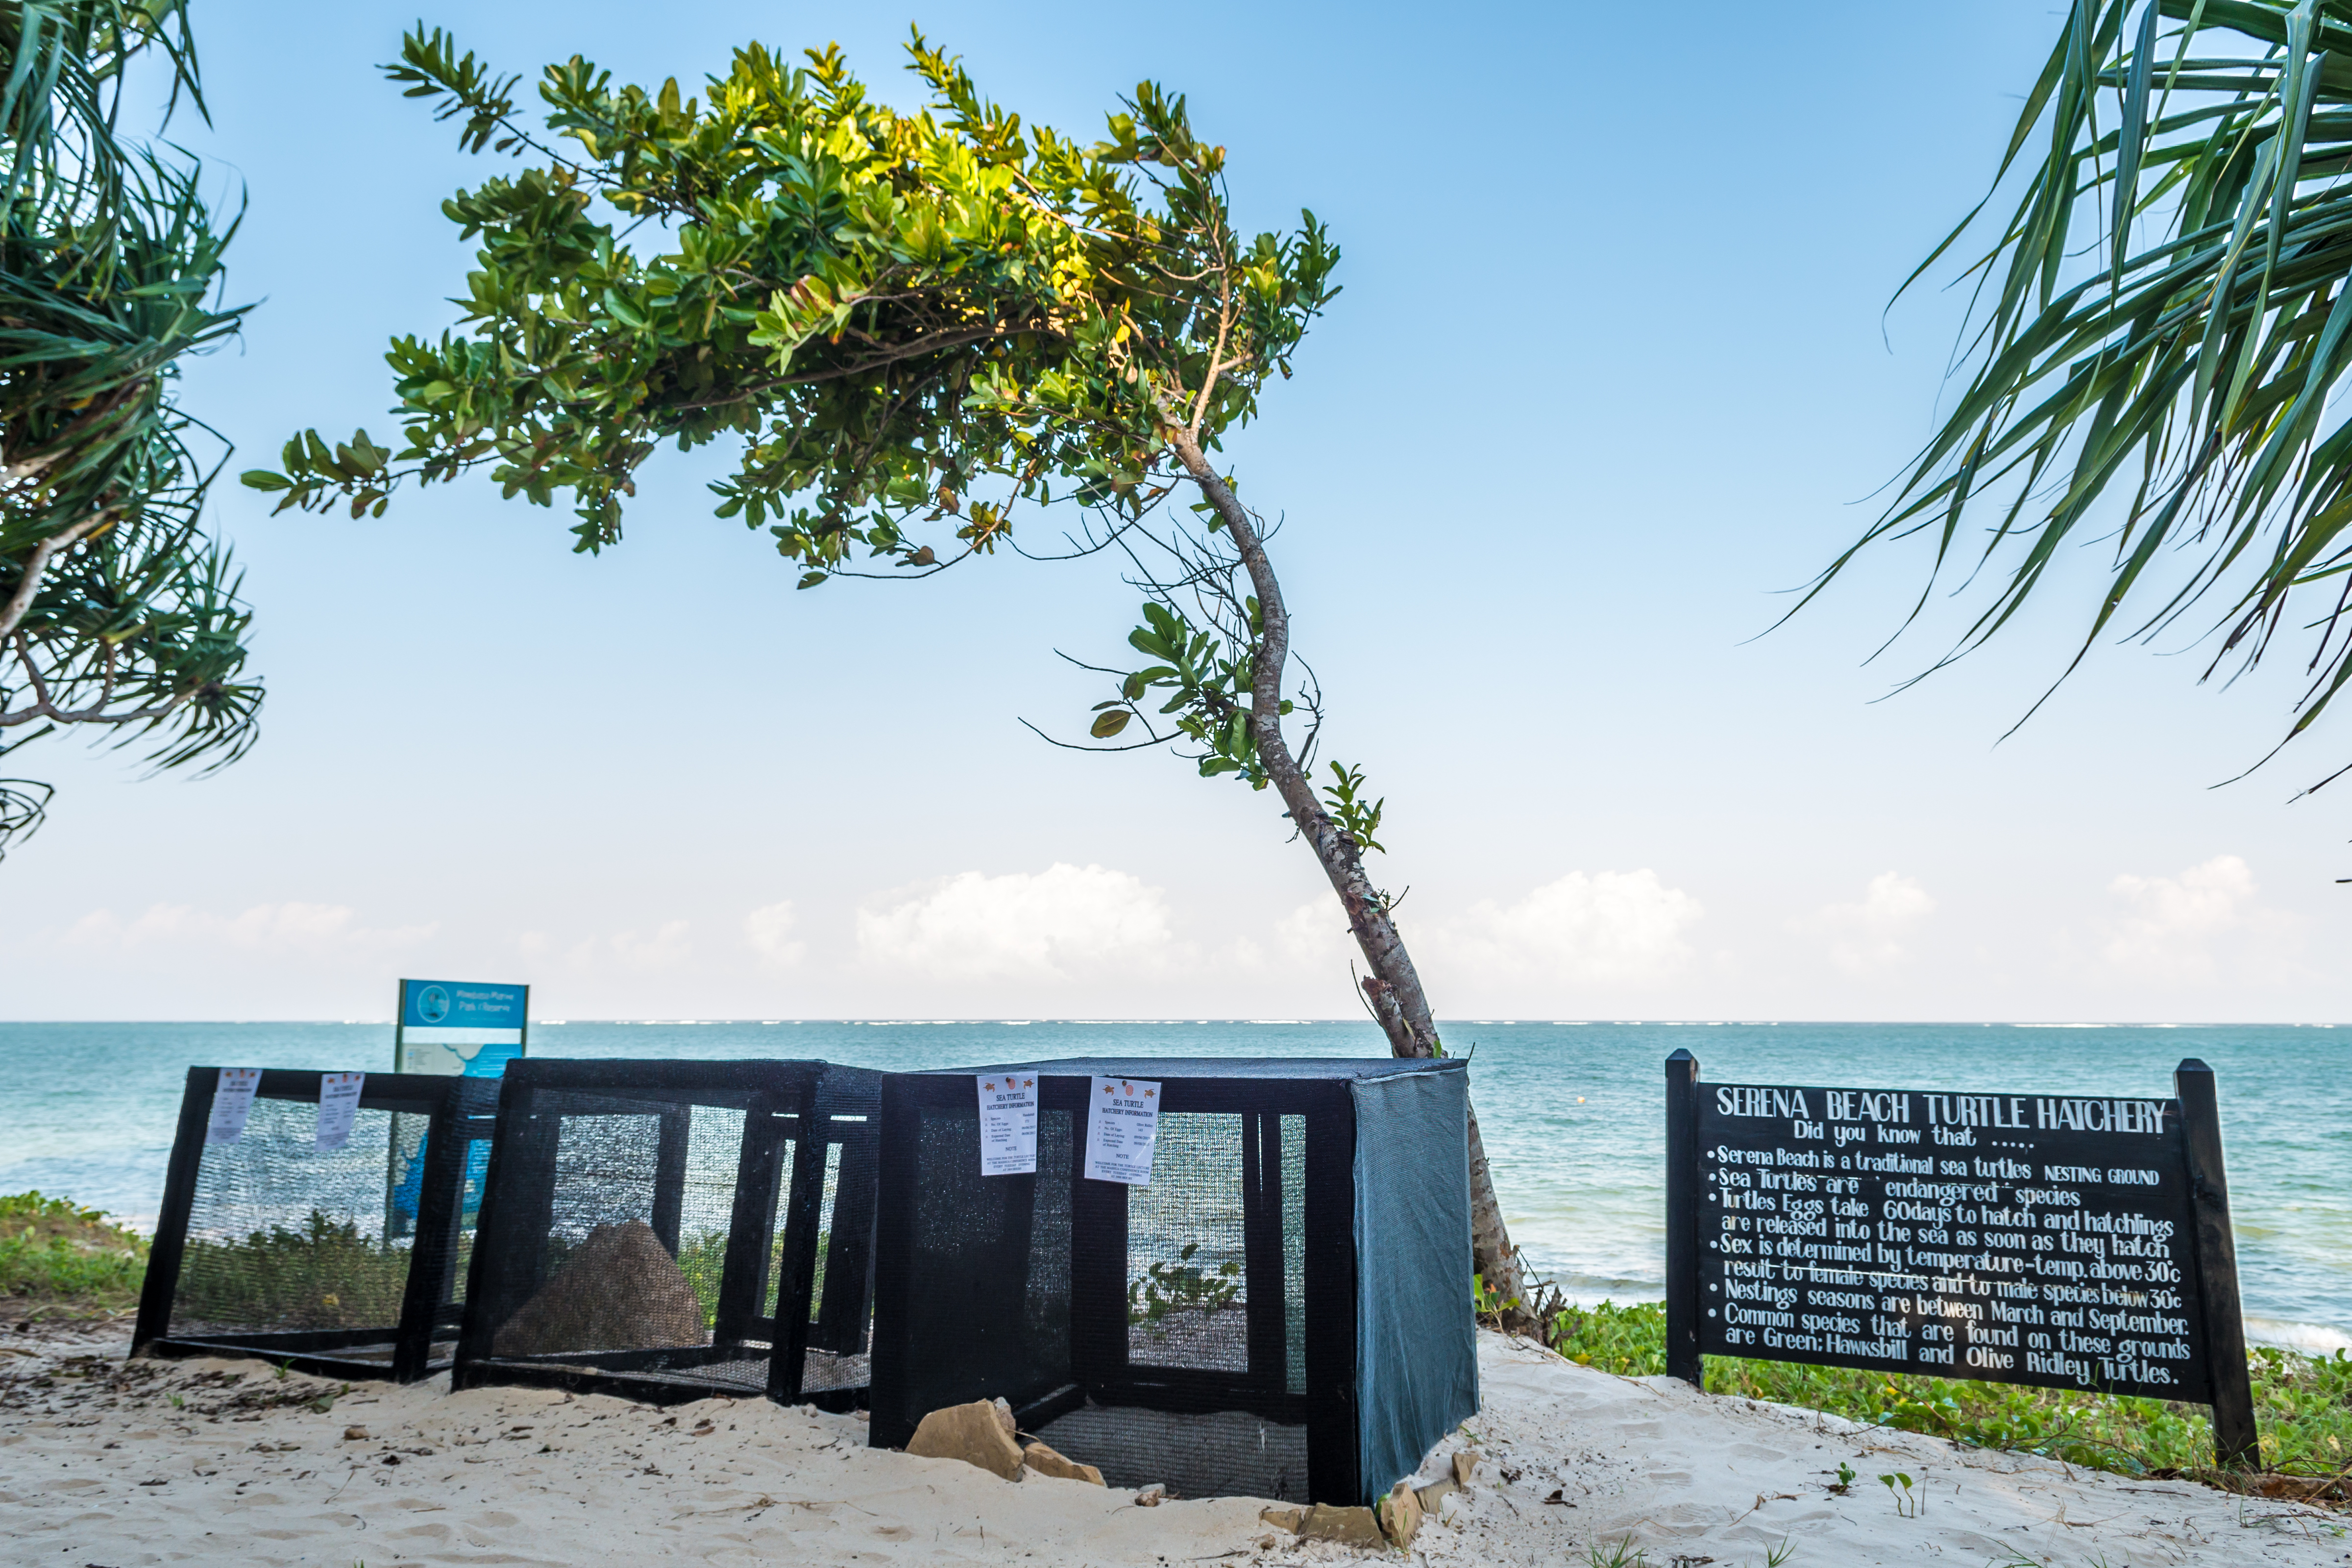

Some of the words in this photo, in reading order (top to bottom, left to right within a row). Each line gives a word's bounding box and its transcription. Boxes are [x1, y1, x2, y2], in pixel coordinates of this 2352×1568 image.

[1006, 1092, 1025, 1101] TURTLE
[1716, 1087, 1809, 1119] SERENA
[1826, 1091, 1909, 1123] BEACH
[1923, 1094, 2030, 1128] TURTLE
[2036, 1098, 2166, 1134] HATCHERY
[1794, 1120, 1823, 1139] Did
[1834, 1126, 1865, 1147] you
[1877, 1124, 1921, 1144] know
[1931, 1125, 1977, 1147] that
[1717, 1145, 1774, 1165] Serena
[1776, 1148, 1819, 1168] Beach
[1823, 1150, 1835, 1169] is
[1841, 1155, 1851, 1170] a
[1855, 1151, 1933, 1175] traditional
[1939, 1160, 1967, 1176] sea
[1974, 1155, 2032, 1179] turtles
[2044, 1165, 2102, 1183] NESTING
[2108, 1169, 2159, 1185] GROUND
[1718, 1168, 1751, 1187] Sea
[1756, 1169, 1817, 1192] Turtles
[1826, 1178, 1859, 1195] are
[1885, 1177, 1998, 1206] endangered
[2015, 1185, 2081, 1208] species
[1719, 1187, 1776, 1211] Turtles
[1782, 1194, 1824, 1221] Eggs
[1830, 1196, 1869, 1217] take
[1955, 1203, 1977, 1224] to
[1981, 1205, 2036, 1227] hatch
[2043, 1210, 2081, 1231] and
[2083, 1210, 2174, 1242] hatchlings
[1721, 1215, 1751, 1231] are
[1756, 1215, 1827, 1237] released
[1835, 1217, 1871, 1240] into
[1876, 1220, 1911, 1242] the
[1918, 1228, 1949, 1245] sea
[1956, 1230, 1977, 1246] as
[1984, 1231, 2026, 1250] soon
[2032, 1234, 2054, 1250] as
[2059, 1231, 2106, 1259] they
[2112, 1234, 2170, 1258] hatch
[1720, 1233, 1753, 1254] Sex
[1759, 1234, 1773, 1256] is
[1776, 1236, 1872, 1263] determined
[1877, 1243, 1902, 1273] by
[2089, 1259, 2142, 1280] above
[1723, 1258, 1776, 1280] result
[1781, 1259, 1803, 1281] to
[1808, 1260, 1863, 1286] female
[1869, 1268, 1929, 1293] species
[1932, 1272, 1963, 1294] and
[1968, 1273, 1991, 1296] to
[1996, 1277, 2038, 1299] male
[2043, 1281, 2100, 1306] species
[2101, 1282, 2149, 1308] below
[1725, 1278, 1798, 1310] Nestings
[1807, 1289, 1875, 1310] seasons
[1881, 1296, 1911, 1314] are
[1916, 1294, 1984, 1320] between
[1990, 1300, 2044, 1325] March
[2050, 1306, 2084, 1328] and
[2088, 1308, 2189, 1336] September.
[1724, 1302, 1794, 1328] Common
[1801, 1311, 1861, 1334] species
[1870, 1314, 1911, 1339] that
[1922, 1323, 1955, 1342] are
[1965, 1320, 2019, 1347] found
[2028, 1332, 2052, 1350] on
[2058, 1328, 2111, 1354] these
[2115, 1337, 2191, 1363] grounds
[1725, 1327, 1755, 1345] are
[1918, 1344, 1955, 1365] and
[1966, 1346, 2014, 1369] Olive
[2027, 1351, 2090, 1386] Ridley
